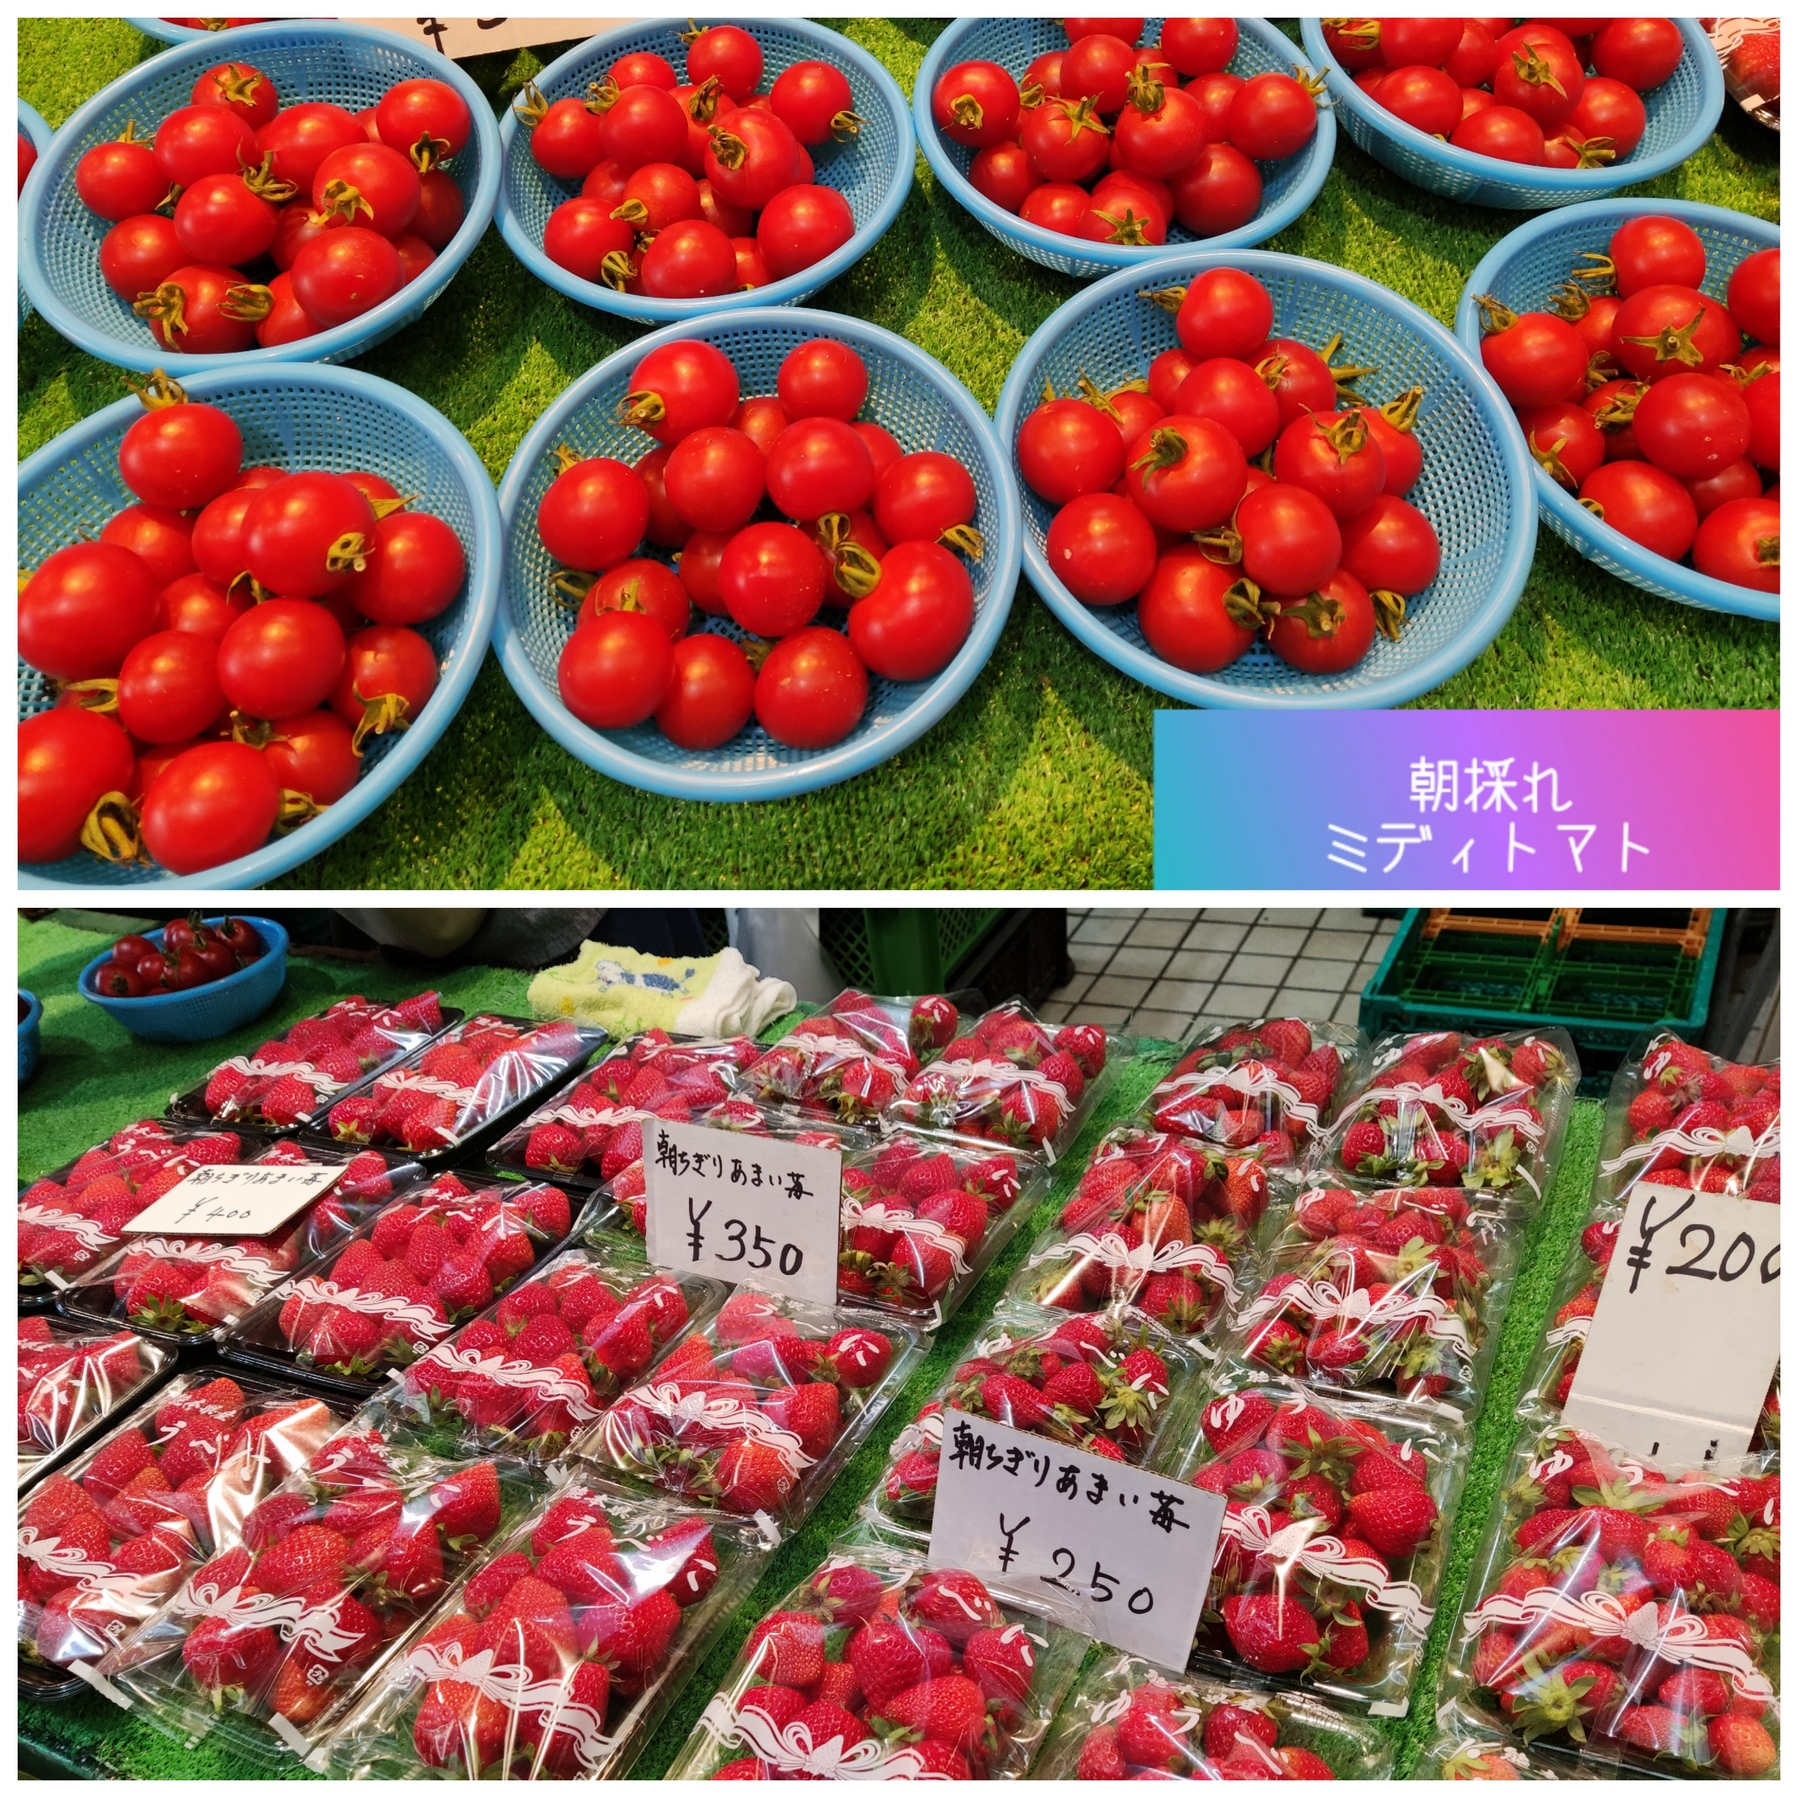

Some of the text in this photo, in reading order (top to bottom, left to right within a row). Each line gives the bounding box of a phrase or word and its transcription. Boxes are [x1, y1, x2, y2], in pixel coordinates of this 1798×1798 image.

[174, 1196, 252, 1224] ¥400
[686, 1196, 804, 1276] ¥350
[998, 1512, 1154, 1615] ¥250
